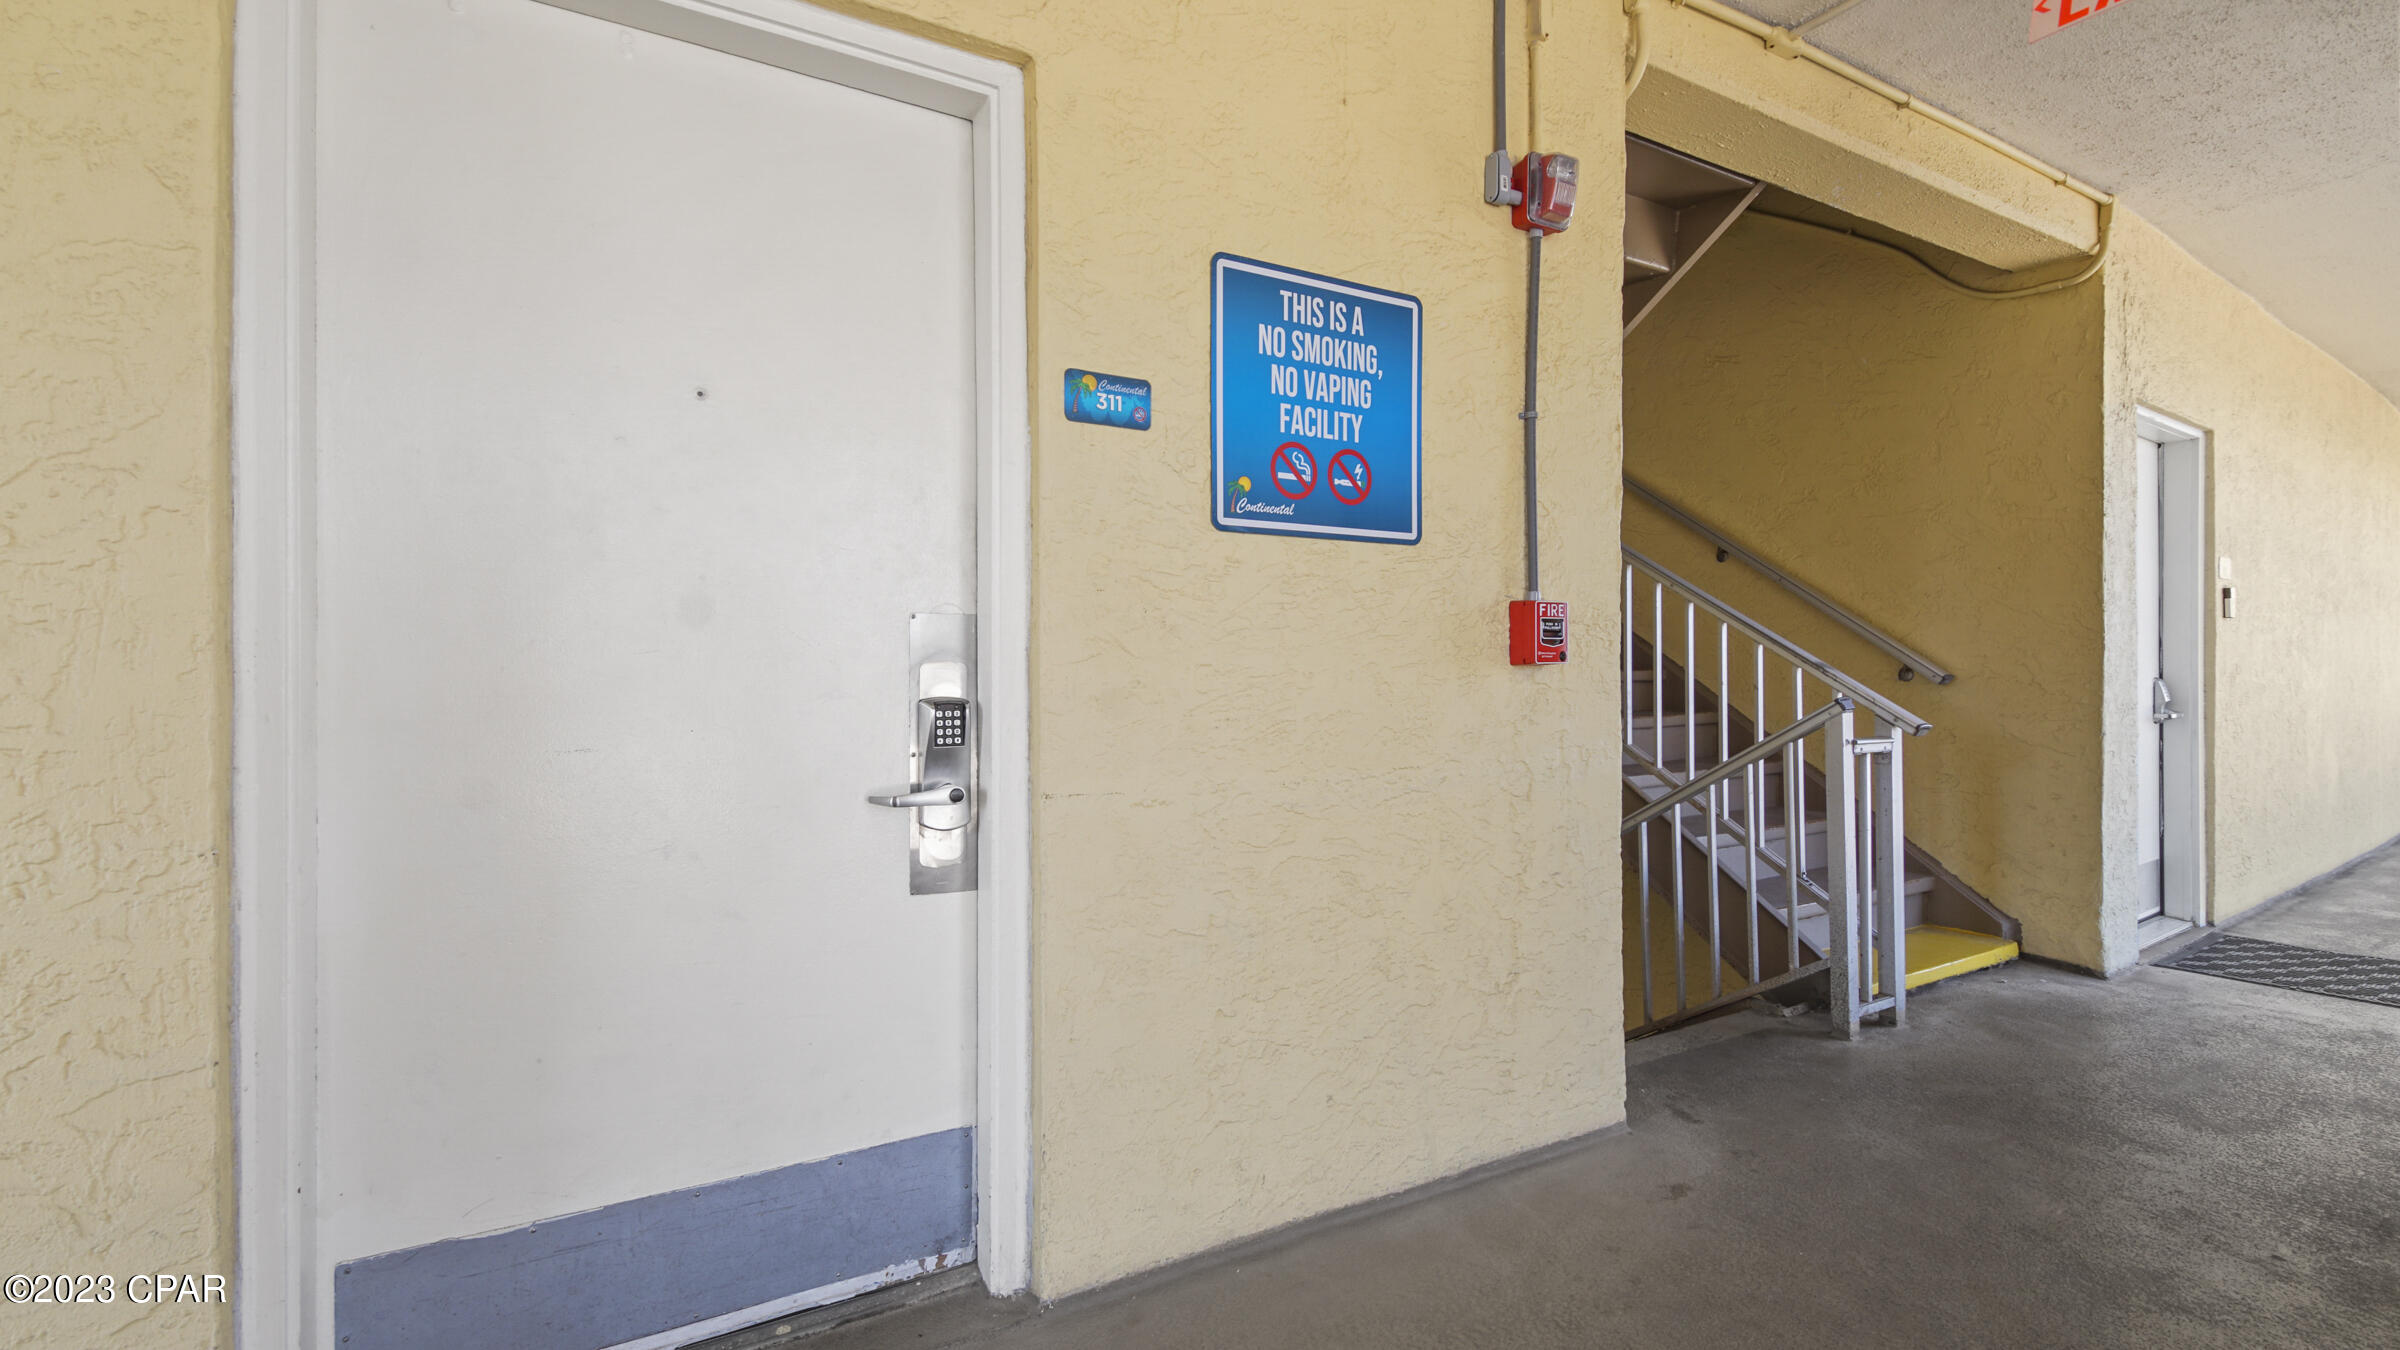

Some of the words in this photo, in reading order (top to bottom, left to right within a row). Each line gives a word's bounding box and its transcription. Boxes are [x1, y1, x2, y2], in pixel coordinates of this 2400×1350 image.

[1280, 290, 1324, 328] THIS
[1329, 300, 1347, 332] IS
[1351, 306, 1364, 336] A
[1258, 323, 1286, 358] NO
[1291, 330, 1383, 380] SMOKING,
[1098, 379, 1147, 396] Continental
[1271, 364, 1298, 398] NO
[1303, 369, 1372, 409] VAPING
[1096, 392, 1122, 412] 311
[1280, 402, 1363, 443] FACILITY
[1236, 497, 1295, 516] Continental
[1539, 603, 1565, 617] FIRE
